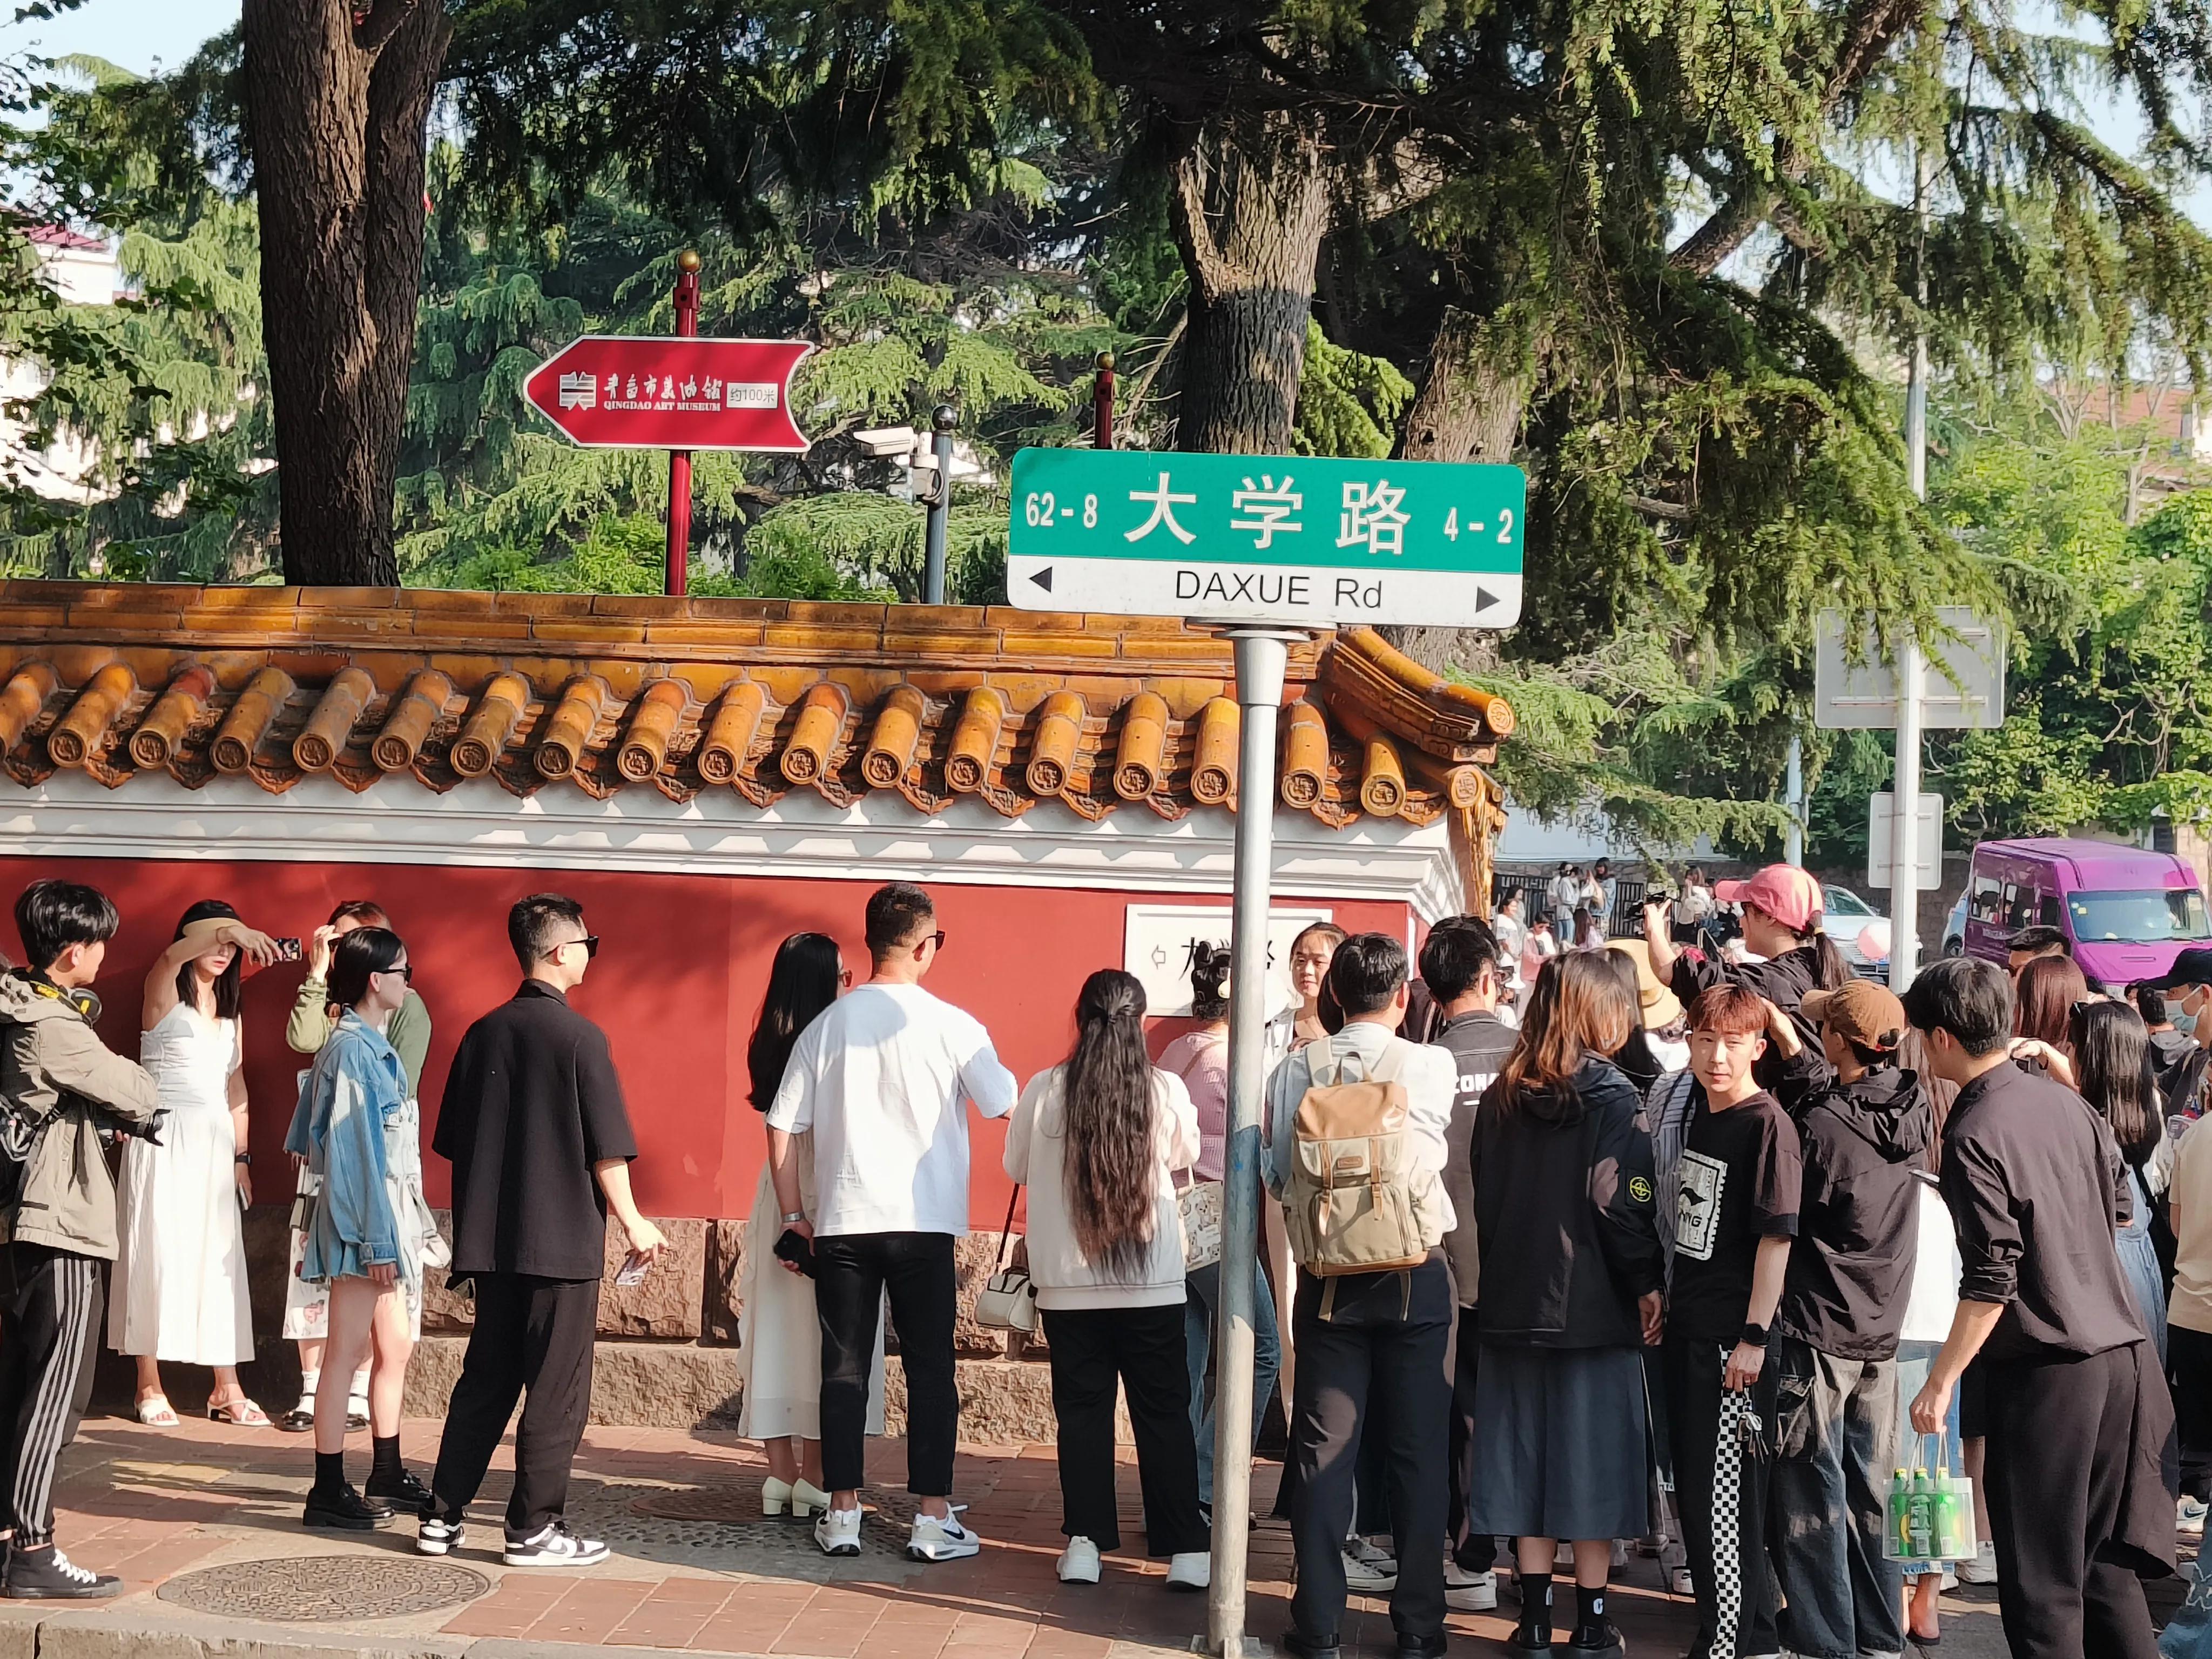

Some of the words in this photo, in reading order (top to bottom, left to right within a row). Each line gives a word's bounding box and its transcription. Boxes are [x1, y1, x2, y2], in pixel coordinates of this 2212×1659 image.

[603, 401, 652, 410] QINGDAO
[677, 402, 720, 412] MUSEUM
[730, 388, 774, 402] 约100米
[1123, 471, 1412, 555] 大学路
[1176, 570, 1310, 605] DAXUE
[1335, 578, 1382, 609] Rd
